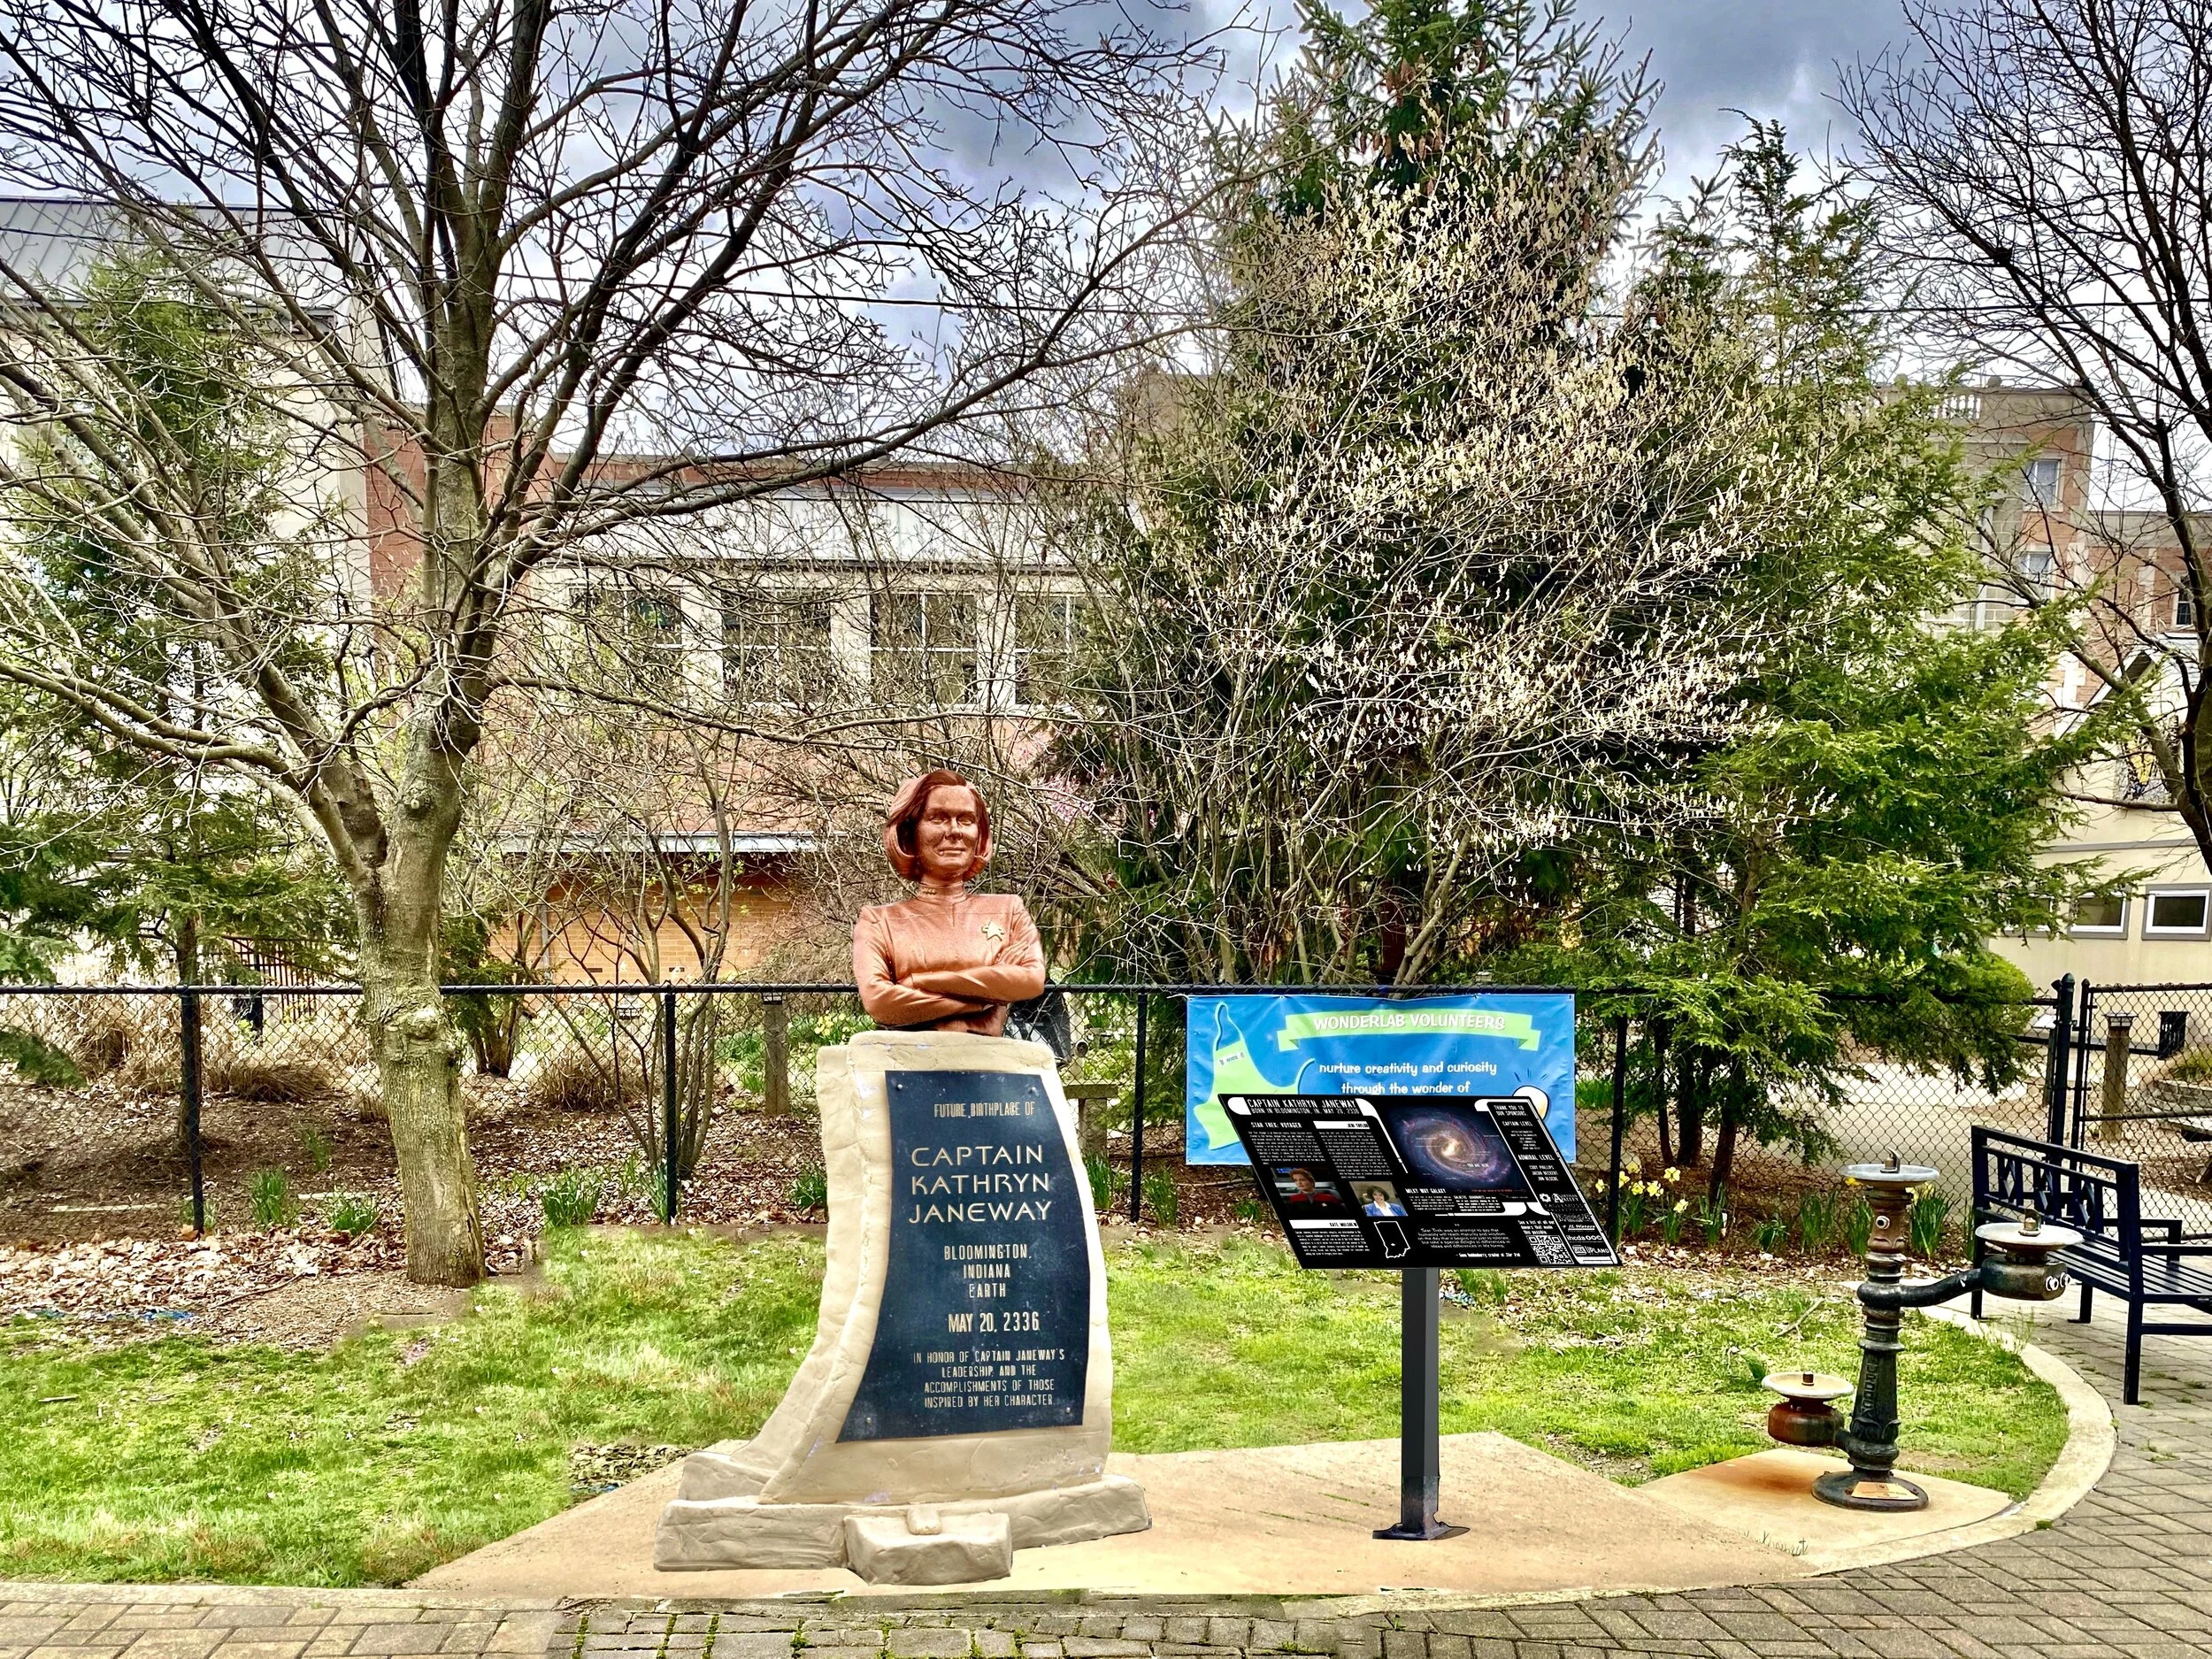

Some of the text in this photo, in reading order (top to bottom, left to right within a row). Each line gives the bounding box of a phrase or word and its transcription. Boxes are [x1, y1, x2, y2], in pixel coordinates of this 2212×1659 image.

[1313, 1013, 1505, 1031] WONDERLAB VOLUNTEERS
[1319, 1061, 1497, 1077] nurture creativity and curiosity
[1341, 1080, 1471, 1095] through the wonder of
[934, 1102, 1036, 1118] FUTURE BIRTHPLACE OF
[1247, 1099, 1356, 1109] CAPTAIN KATHRYN JANEWAY
[911, 1144, 1043, 1166] CAPTAIN
[911, 1172, 1050, 1195] KATHRYN
[909, 1201, 1052, 1224] JANEWAY
[944, 1243, 1032, 1260] BLOOMINGTON,
[963, 1263, 1011, 1279] INDIANA
[969, 1283, 1006, 1298] EARTH
[949, 1311, 1040, 1333] MAY 20, 2336
[913, 1348, 1065, 1363] IN HONOR OF CAPTAIN JANEWAY'S
[999, 1365, 1016, 1377] AND
[1021, 1364, 1037, 1376] THE
[925, 1379, 1055, 1393] ACCOMPLISHMENTS OF THOSE
[925, 1394, 1056, 1409] INSPIRED BY HER CHARACTER.
